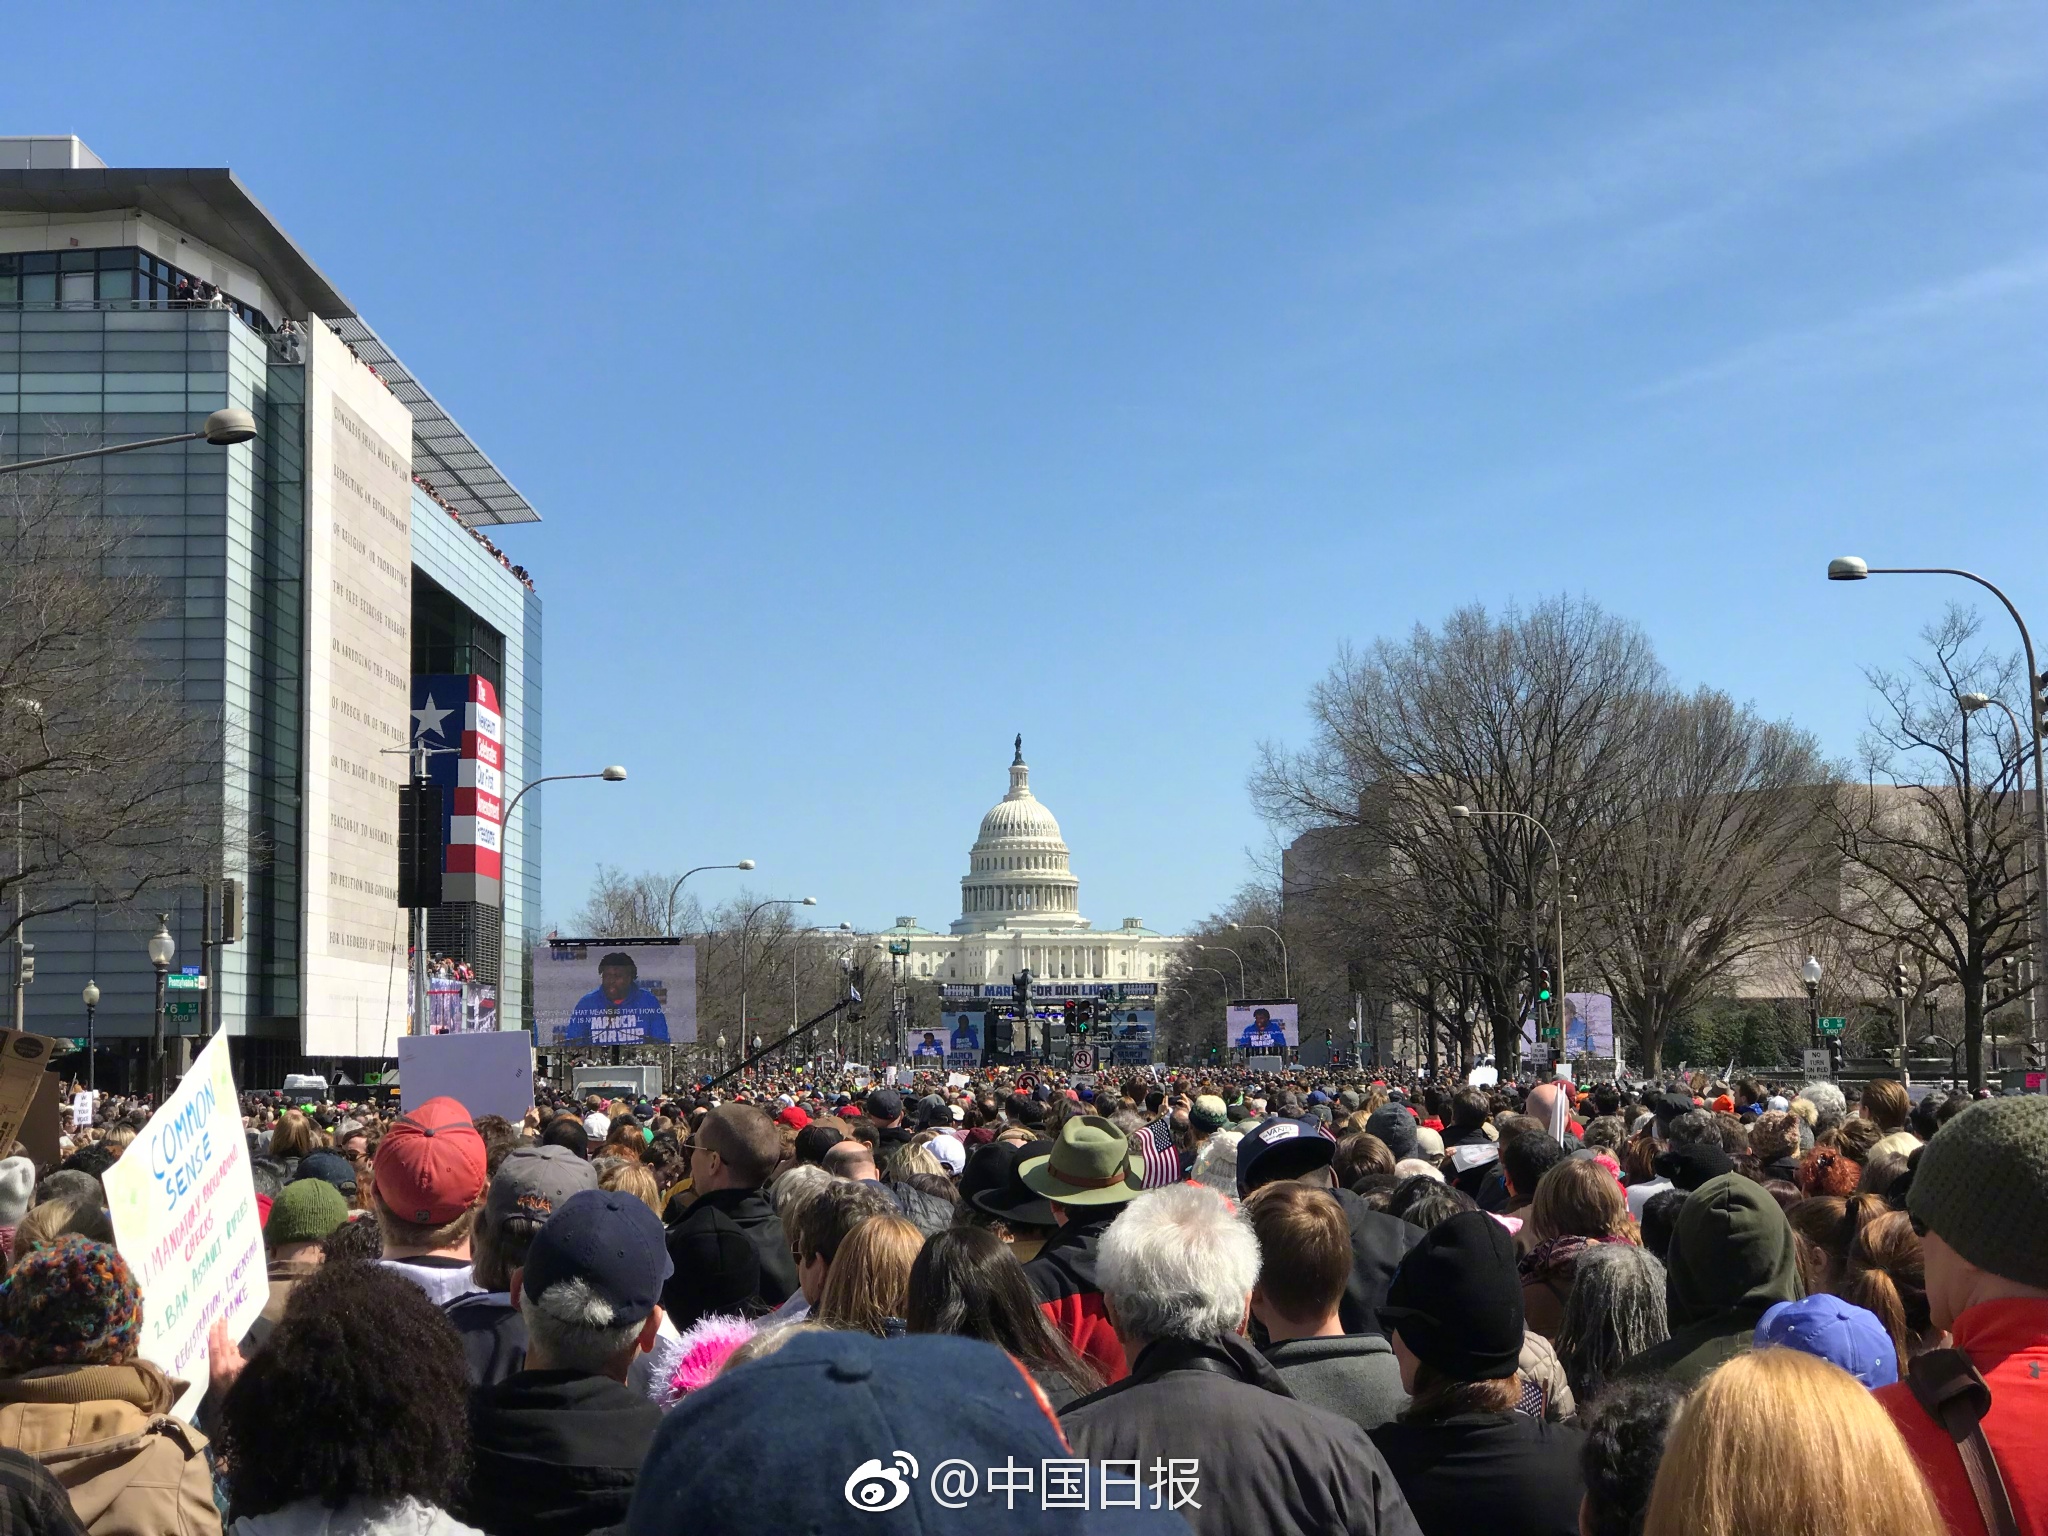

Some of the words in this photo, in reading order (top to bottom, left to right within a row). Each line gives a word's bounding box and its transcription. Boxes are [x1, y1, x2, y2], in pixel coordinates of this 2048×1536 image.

[334, 406, 361, 441] CONGRESS
[362, 432, 376, 456] SHALL
[378, 446, 390, 468] MAKE
[391, 460, 398, 474] NO
[399, 466, 408, 483] LAW
[334, 464, 363, 498] RESPECTING
[364, 490, 371, 504] AN
[372, 497, 407, 536] ESTABLISHMENT
[333, 522, 340, 536] OF
[369, 550, 376, 564] OR
[377, 555, 407, 588] PROHIBITING
[333, 580, 343, 597] THE
[346, 588, 358, 607] FREE
[360, 598, 382, 624] EXERCISE
[332, 637, 340, 651] OR
[342, 645, 371, 672] ABRIDGING
[373, 662, 383, 679] THE
[385, 669, 406, 692] FREEDOM
[477, 680, 486, 702] The
[332, 696, 339, 710] OF
[363, 712, 370, 727] OR
[372, 717, 378, 730] OF
[380, 720, 390, 736] THE
[477, 708, 496, 736] Newseum
[478, 736, 498, 765] Celebrates
[331, 754, 339, 768] OR
[340, 758, 350, 774] THE
[352, 763, 368, 782] RIGHT
[370, 772, 376, 785] OF
[378, 776, 388, 790] THE
[477, 764, 485, 785] Our
[485, 768, 494, 790] First
[476, 792, 500, 820] Amendment
[330, 813, 359, 834] PEACEABLY
[361, 823, 367, 837] TO
[477, 820, 495, 846] Freedoms
[330, 872, 337, 886] TO
[339, 875, 363, 891] PETITION
[364, 881, 374, 894] THE
[329, 931, 339, 945] FOR
[346, 934, 367, 950] REDRESS
[369, 938, 375, 951] OF
[985, 985, 1017, 996] MAR
[1055, 984, 1079, 996] OUR
[170, 1004, 178, 1014] 6
[591, 1015, 636, 1030] MARCH
[1823, 1019, 1829, 1027] 6
[592, 1030, 616, 1043] FOR
[618, 1028, 644, 1041] OUR
[152, 1078, 216, 1180] COMMON
[166, 1130, 212, 1211] SENSE
[151, 1194, 200, 1276] MANDATORY
[202, 1143, 238, 1204] BACKGROUND
[184, 1208, 213, 1262] CHECKS
[154, 1320, 166, 1340] 2.
[165, 1284, 189, 1330] BAN
[192, 1234, 222, 1292] ASSAULT
[226, 1196, 248, 1240] RIFLES
[174, 1290, 225, 1376] REGISTRATION,
[200, 1347, 206, 1360] &
